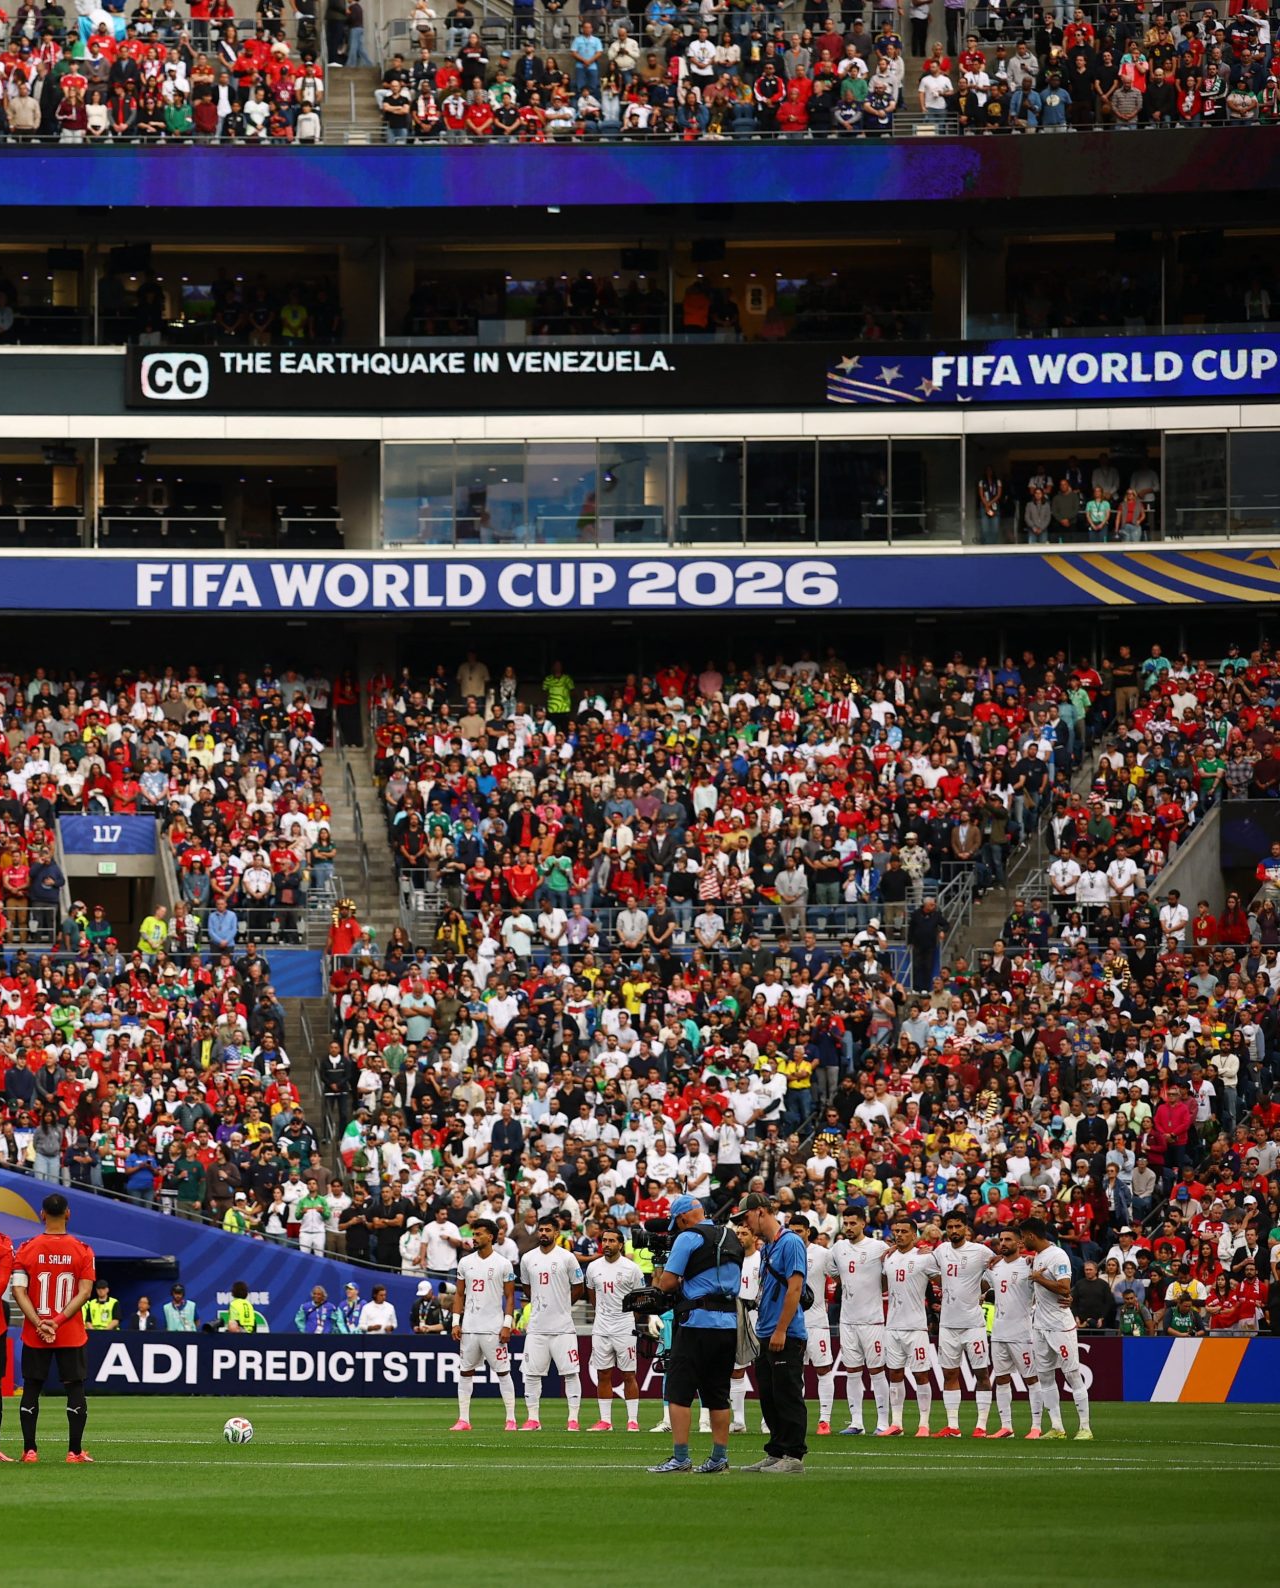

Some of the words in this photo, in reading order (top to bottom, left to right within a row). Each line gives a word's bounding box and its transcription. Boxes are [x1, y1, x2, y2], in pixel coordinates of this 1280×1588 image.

[221, 352, 272, 373] THE
[280, 352, 465, 375] EARTHQUAKE
[474, 352, 499, 373] IN
[507, 351, 676, 373] VENEZUELA.
[932, 356, 1020, 387] FIFA
[1028, 352, 1183, 384] WORLD
[1192, 348, 1278, 381] CUP
[148, 360, 201, 394] CC
[137, 564, 262, 607] FIFA
[270, 563, 486, 607] WORLD
[497, 563, 616, 607] CUP
[628, 561, 839, 606] 2026
[93, 825, 122, 842] 117
[38, 1254, 47, 1265] M.
[48, 1254, 72, 1265] SALAH
[848, 1260, 856, 1274] 6
[895, 1268, 906, 1282] 19
[946, 1263, 958, 1278] 21
[472, 1279, 485, 1293] 23
[538, 1272, 550, 1285] 13
[36, 1271, 76, 1316] 10
[603, 1280, 614, 1294] 14
[1000, 1279, 1008, 1294] 5
[495, 1346, 508, 1361] 23
[818, 1339, 827, 1353] 9
[874, 1340, 882, 1354] 6
[973, 1340, 986, 1355] 21
[1059, 1344, 1069, 1359] 8
[567, 1349, 579, 1363] 13
[914, 1347, 926, 1361] 19
[1022, 1352, 1031, 1366] 5
[95, 1343, 198, 1384] ADI
[213, 1350, 526, 1384] PREDICTSTR
